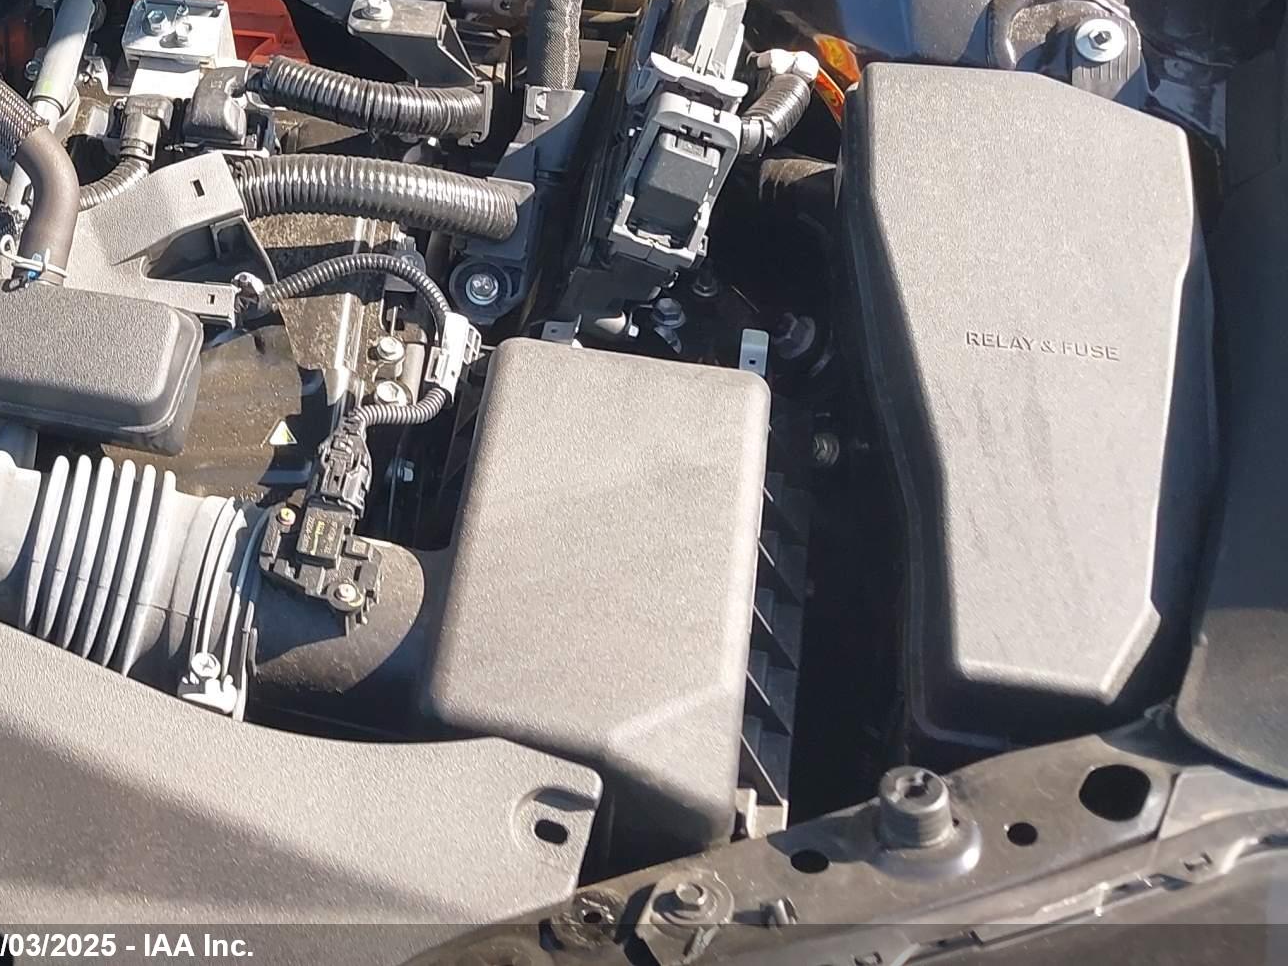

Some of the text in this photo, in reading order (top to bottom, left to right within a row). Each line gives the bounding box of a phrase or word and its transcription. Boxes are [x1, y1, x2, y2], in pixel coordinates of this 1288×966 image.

[965, 331, 1121, 362] RELAY & FUSE
